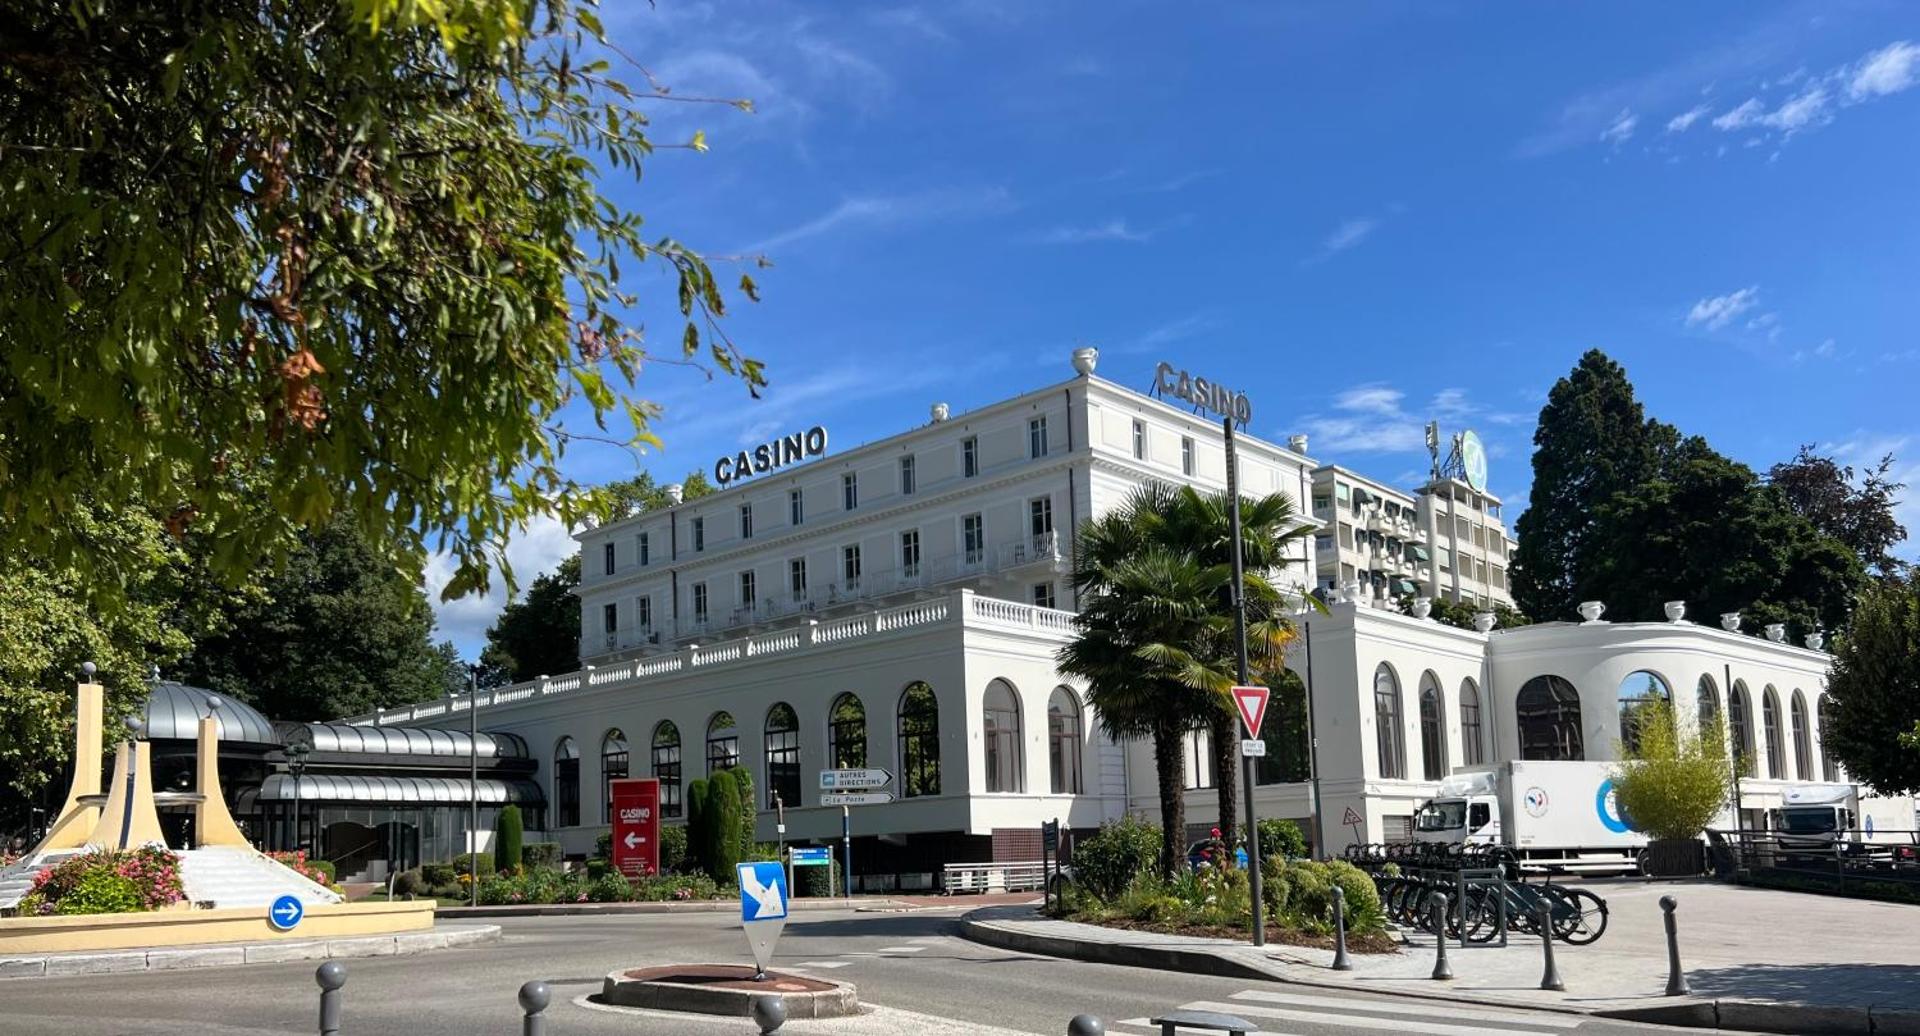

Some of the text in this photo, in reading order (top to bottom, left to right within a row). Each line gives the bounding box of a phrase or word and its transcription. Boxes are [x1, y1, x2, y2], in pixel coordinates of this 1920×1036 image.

[1156, 362, 1251, 424] CASINO
[715, 426, 828, 484] CASINO
[620, 808, 650, 819] CASINO
